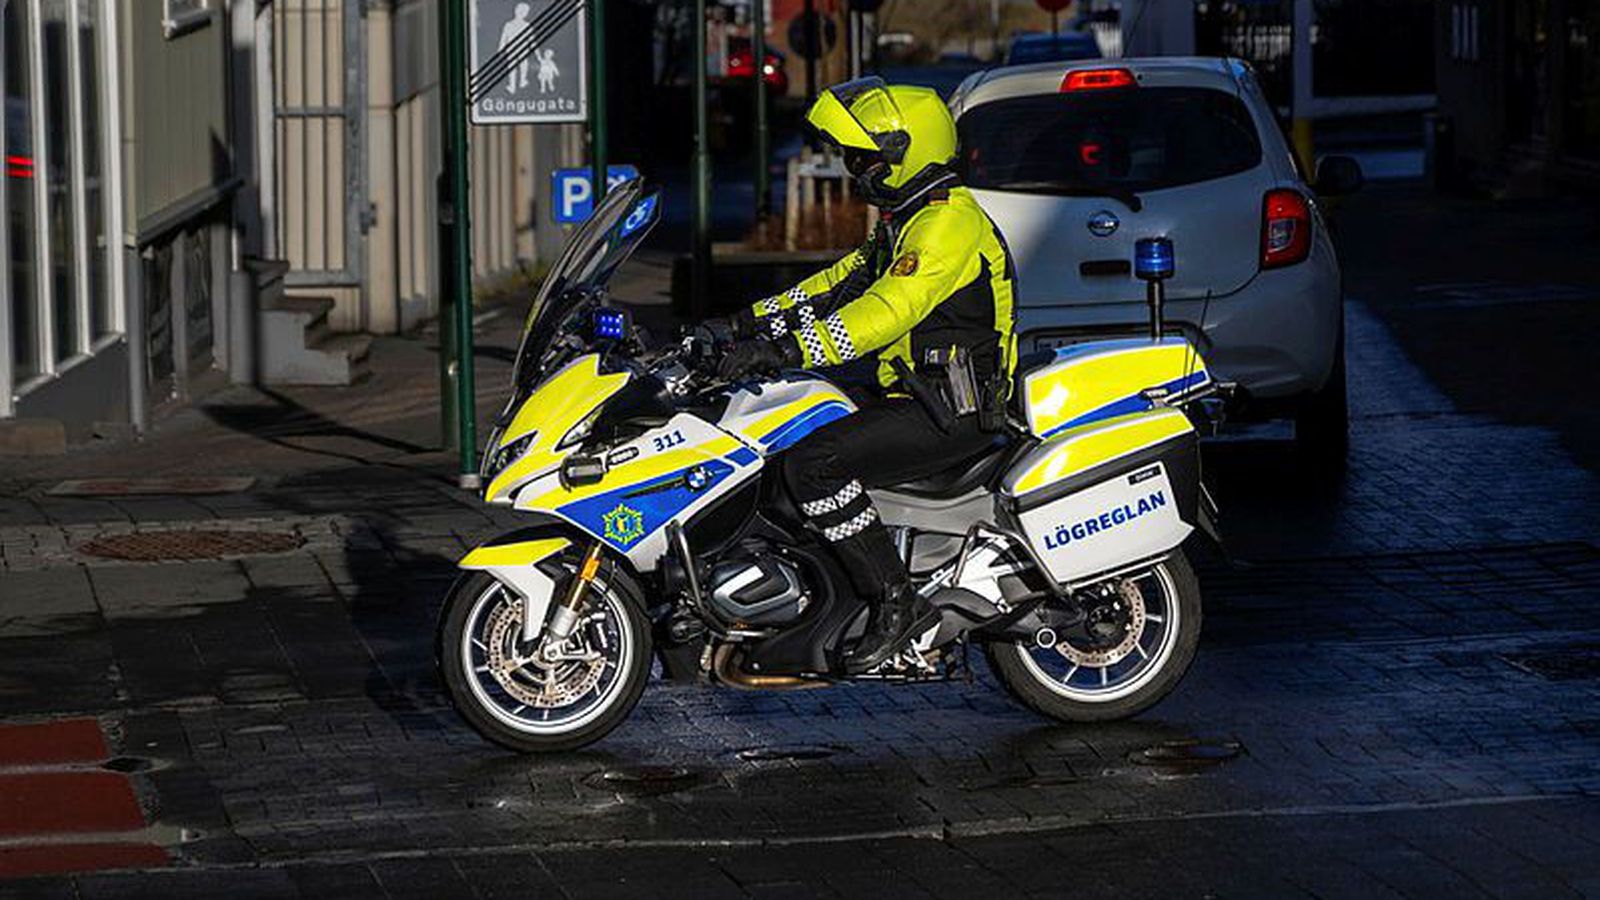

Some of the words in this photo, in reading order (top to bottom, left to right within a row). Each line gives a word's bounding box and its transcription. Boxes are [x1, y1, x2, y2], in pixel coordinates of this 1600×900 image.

[482, 97, 575, 113] Göngugata
[563, 176, 592, 217] P
[653, 430, 686, 452] 311
[1043, 490, 1166, 550] LÖGREGLAN
